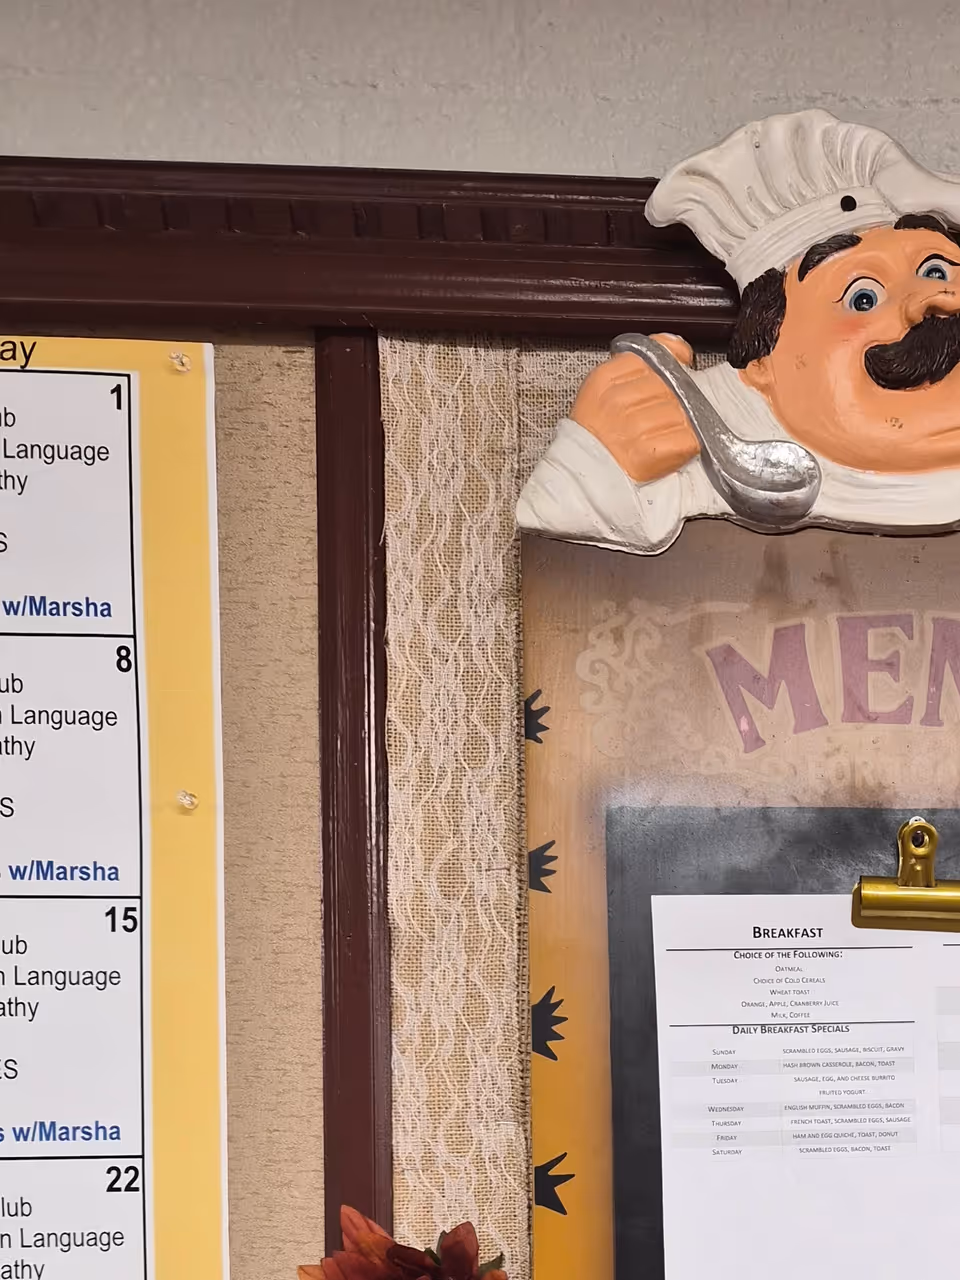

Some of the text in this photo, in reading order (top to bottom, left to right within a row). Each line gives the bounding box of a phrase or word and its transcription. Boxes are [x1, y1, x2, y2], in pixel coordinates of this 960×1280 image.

[111, 384, 121, 410] 1
[4, 438, 109, 466] Language
[3, 595, 112, 617] w/Marsha
[116, 646, 132, 672] 8
[11, 704, 117, 731] Language
[8, 860, 119, 881] w/Marsha
[105, 907, 137, 932] 15
[15, 966, 120, 991] Language
[12, 1121, 120, 1141] w/Marsha
[106, 1166, 139, 1192] 22
[20, 1228, 124, 1252] Language
